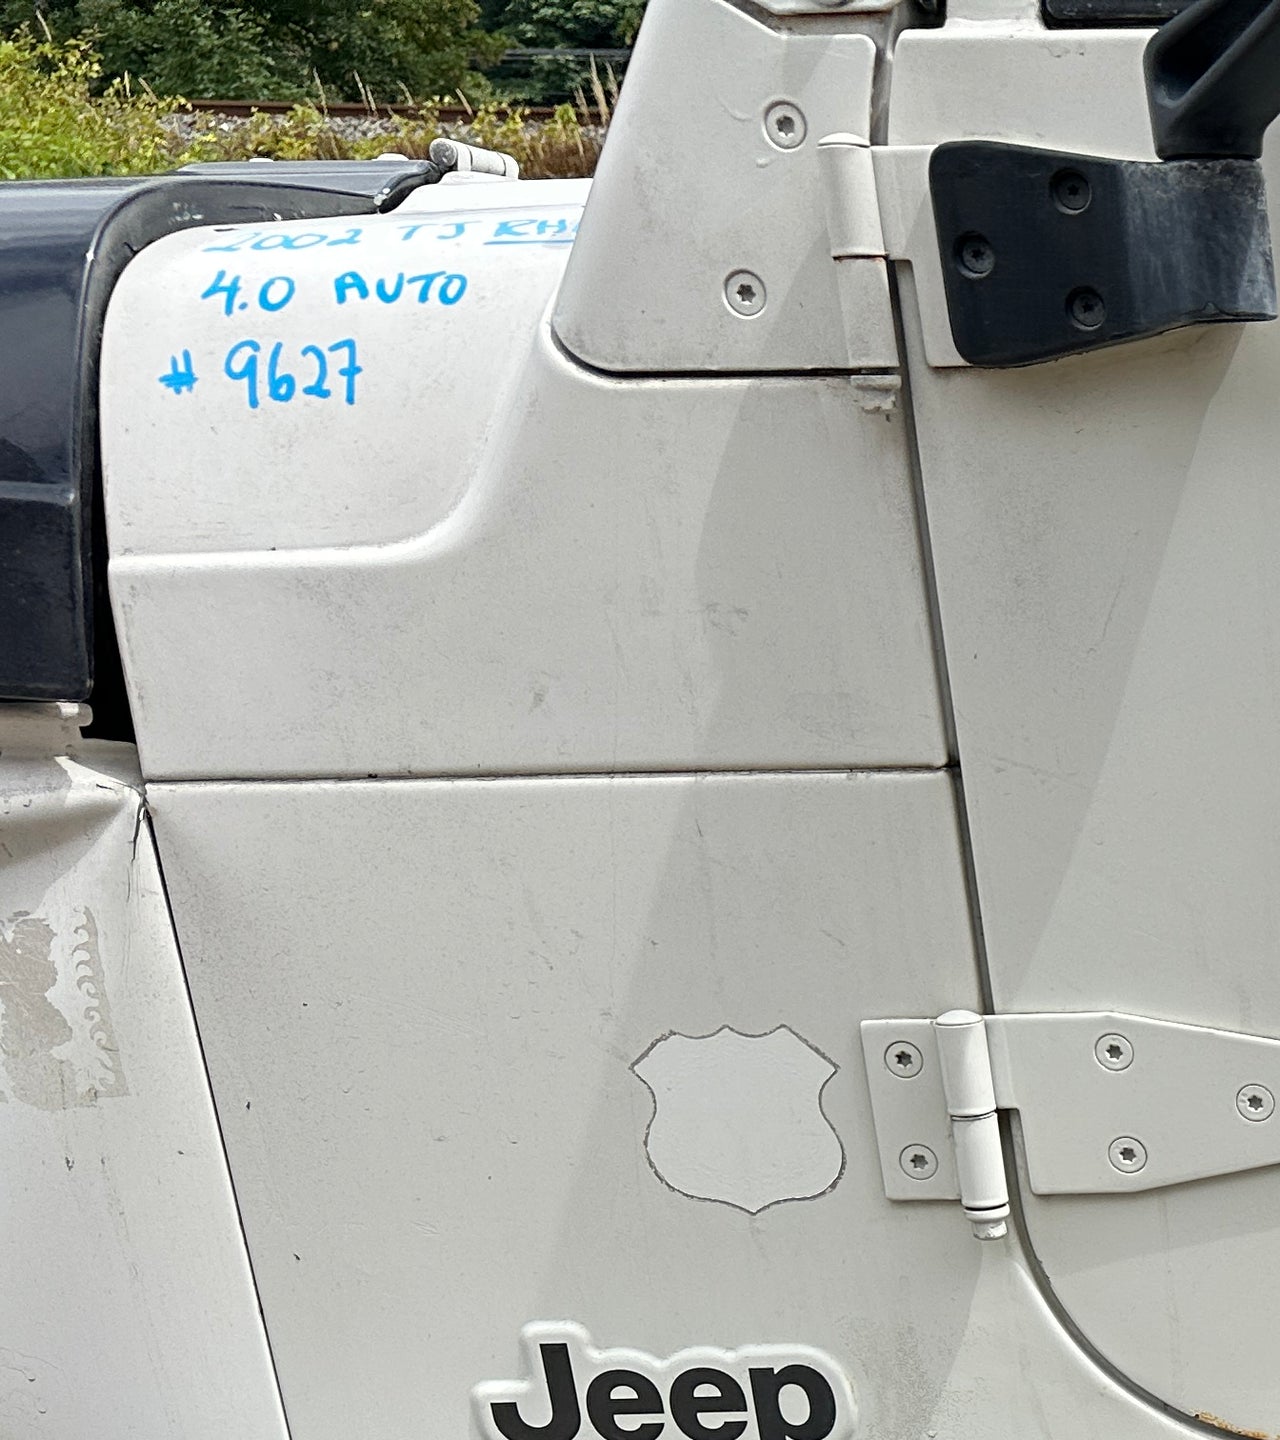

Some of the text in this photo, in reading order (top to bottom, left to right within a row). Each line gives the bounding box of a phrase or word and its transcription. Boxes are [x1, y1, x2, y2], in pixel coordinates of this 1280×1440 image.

[202, 218, 576, 252] 2002 TJ RH
[201, 270, 467, 316] 4.0 AUTO
